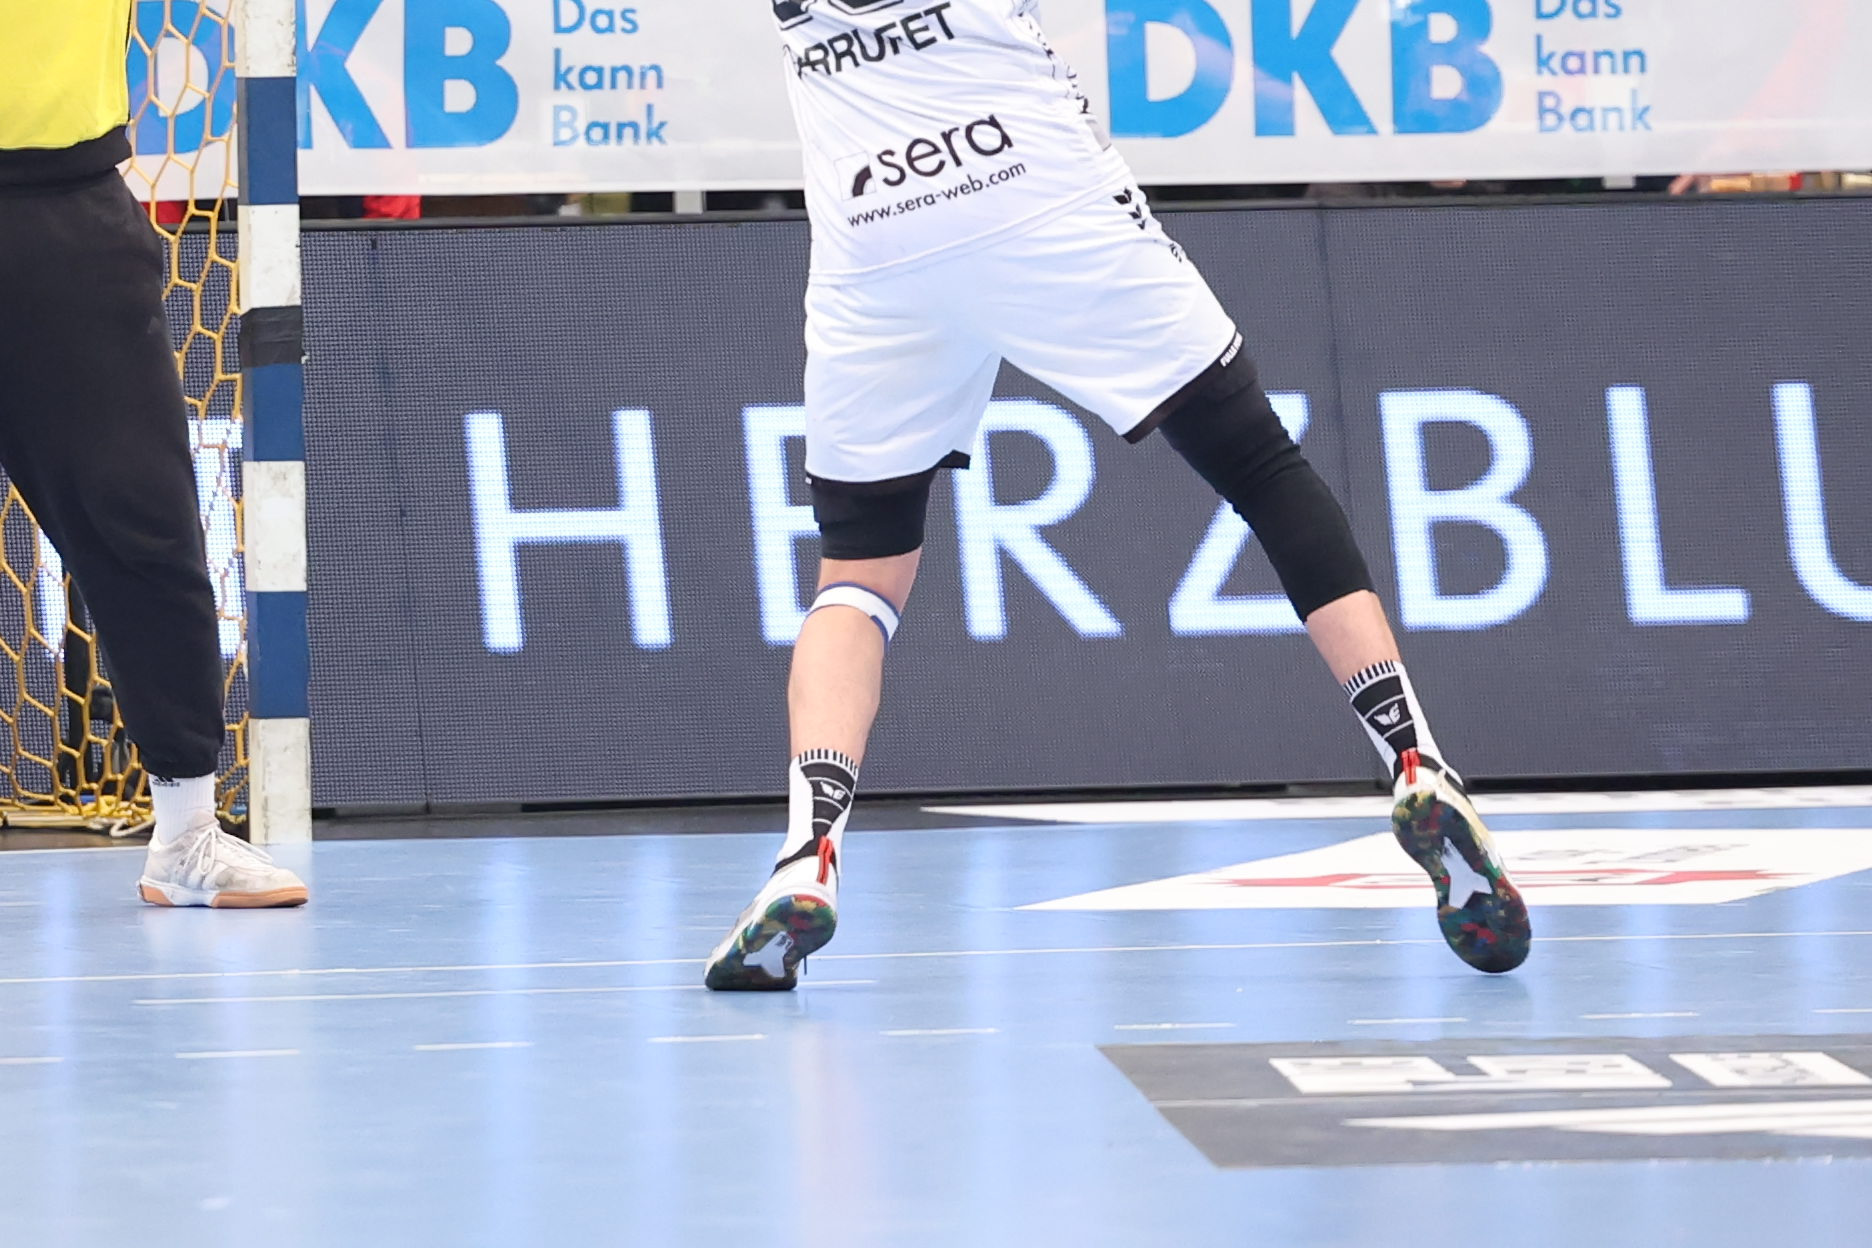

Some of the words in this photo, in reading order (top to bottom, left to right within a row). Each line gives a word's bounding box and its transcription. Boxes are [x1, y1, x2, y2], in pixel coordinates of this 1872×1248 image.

[553, 48, 664, 91] kann
[1536, 35, 1646, 76] kann
[552, 104, 669, 147] Bank
[1538, 90, 1652, 133] Bank
[877, 114, 1014, 187] sera
[847, 162, 1027, 227] www.sera-web.com
